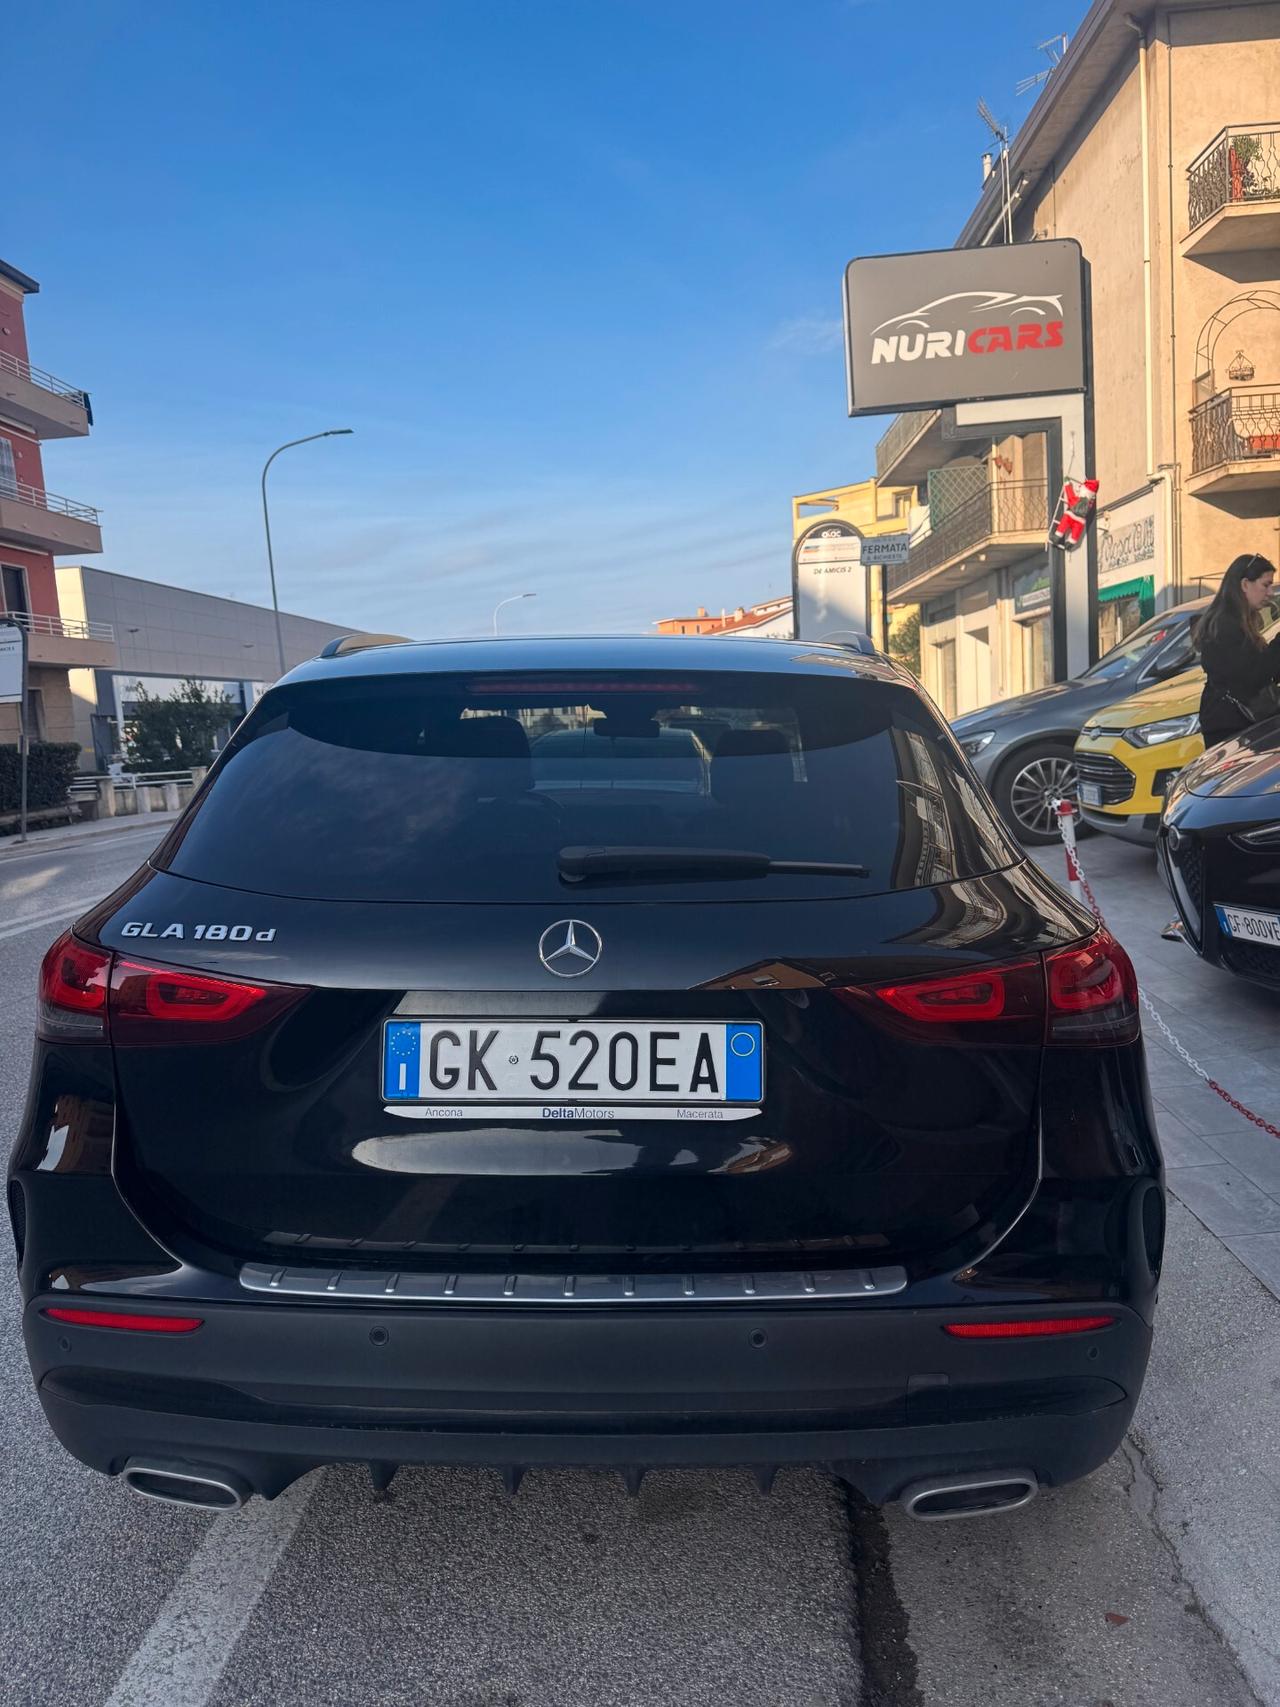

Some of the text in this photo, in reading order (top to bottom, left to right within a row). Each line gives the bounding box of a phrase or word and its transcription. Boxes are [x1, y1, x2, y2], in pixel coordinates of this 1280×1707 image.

[871, 321, 1064, 364] NURICARS
[862, 543, 907, 554] FERMATA
[121, 922, 184, 939] GLA
[425, 1107, 724, 1119] Ancona DeltaMotors Macerata
